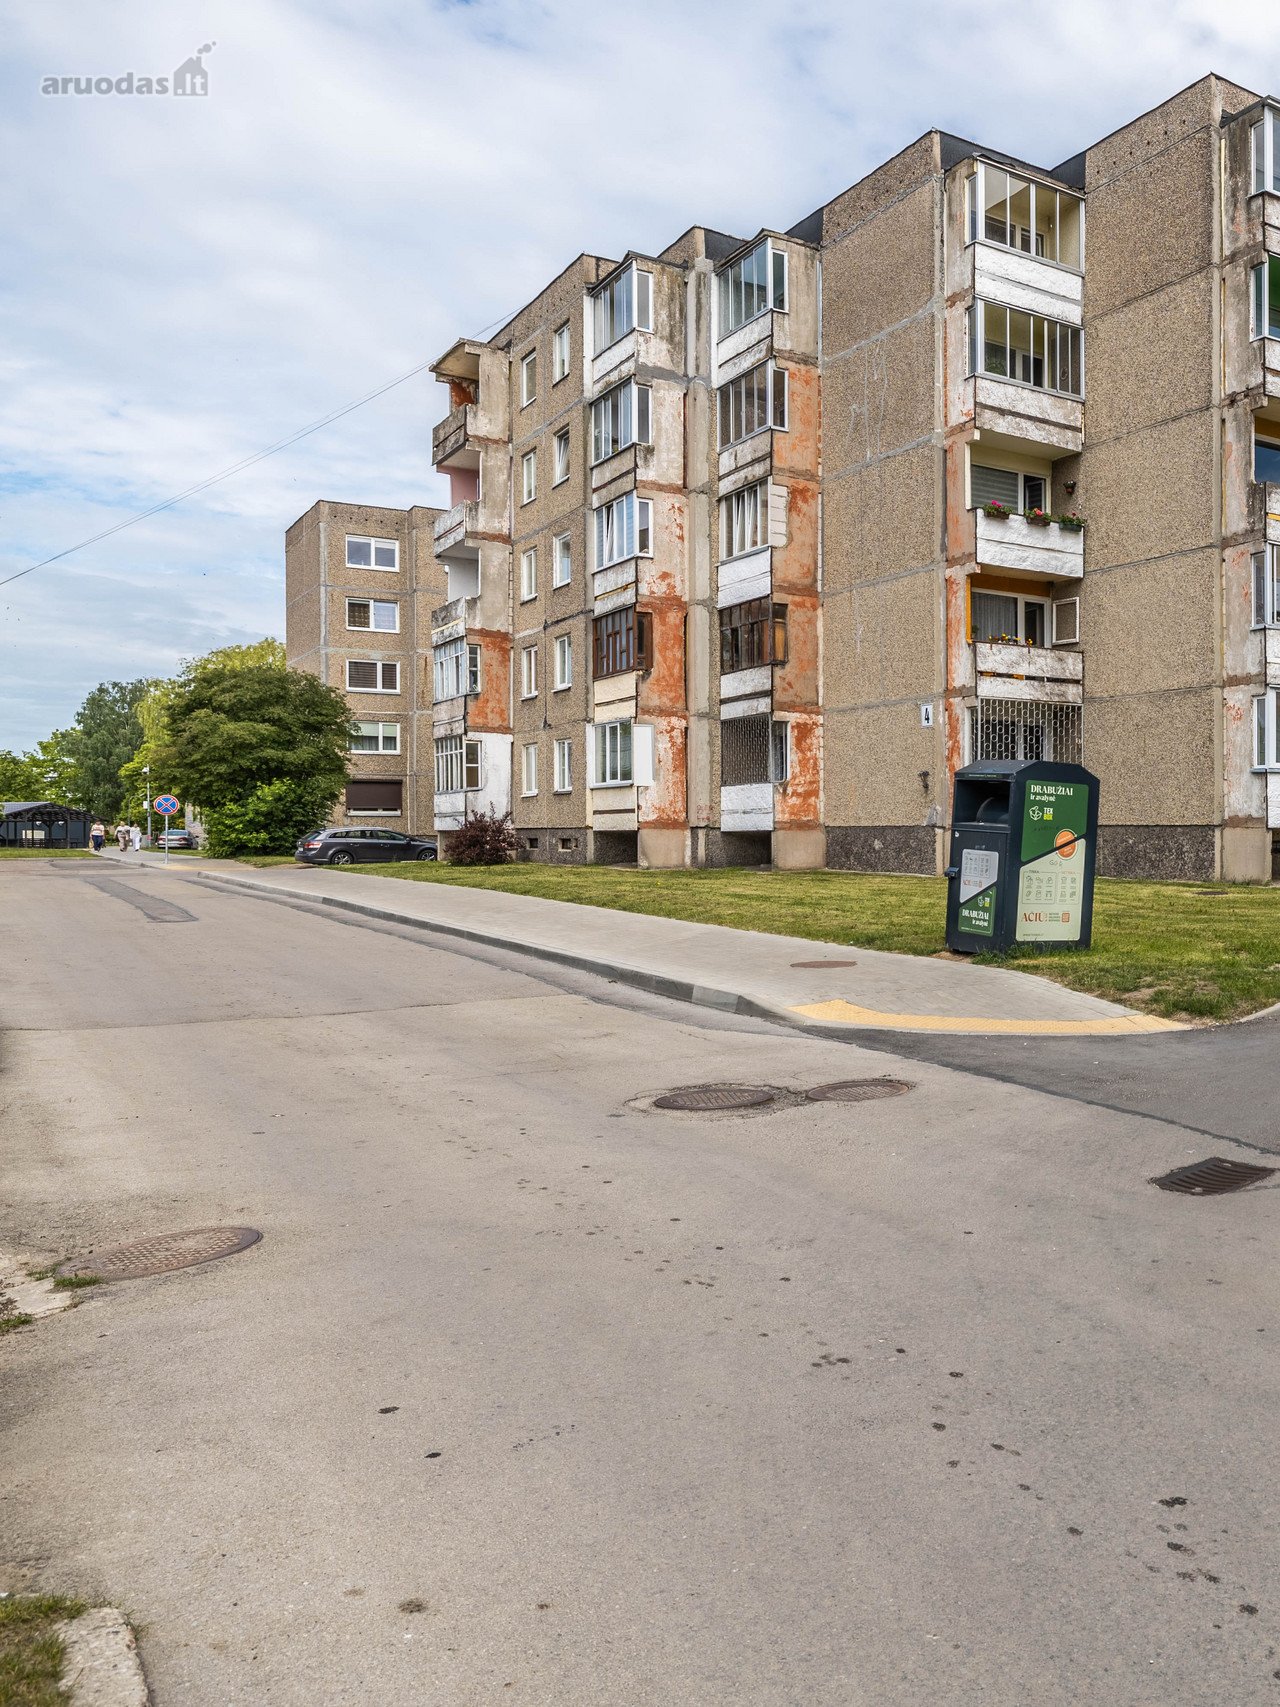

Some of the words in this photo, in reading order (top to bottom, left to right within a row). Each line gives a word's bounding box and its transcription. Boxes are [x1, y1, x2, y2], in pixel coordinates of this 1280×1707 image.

[924, 707, 930, 724] 4
[1031, 785, 1073, 796] DRABUŽIAI
[962, 909, 989, 920] DRABUŽIAI
